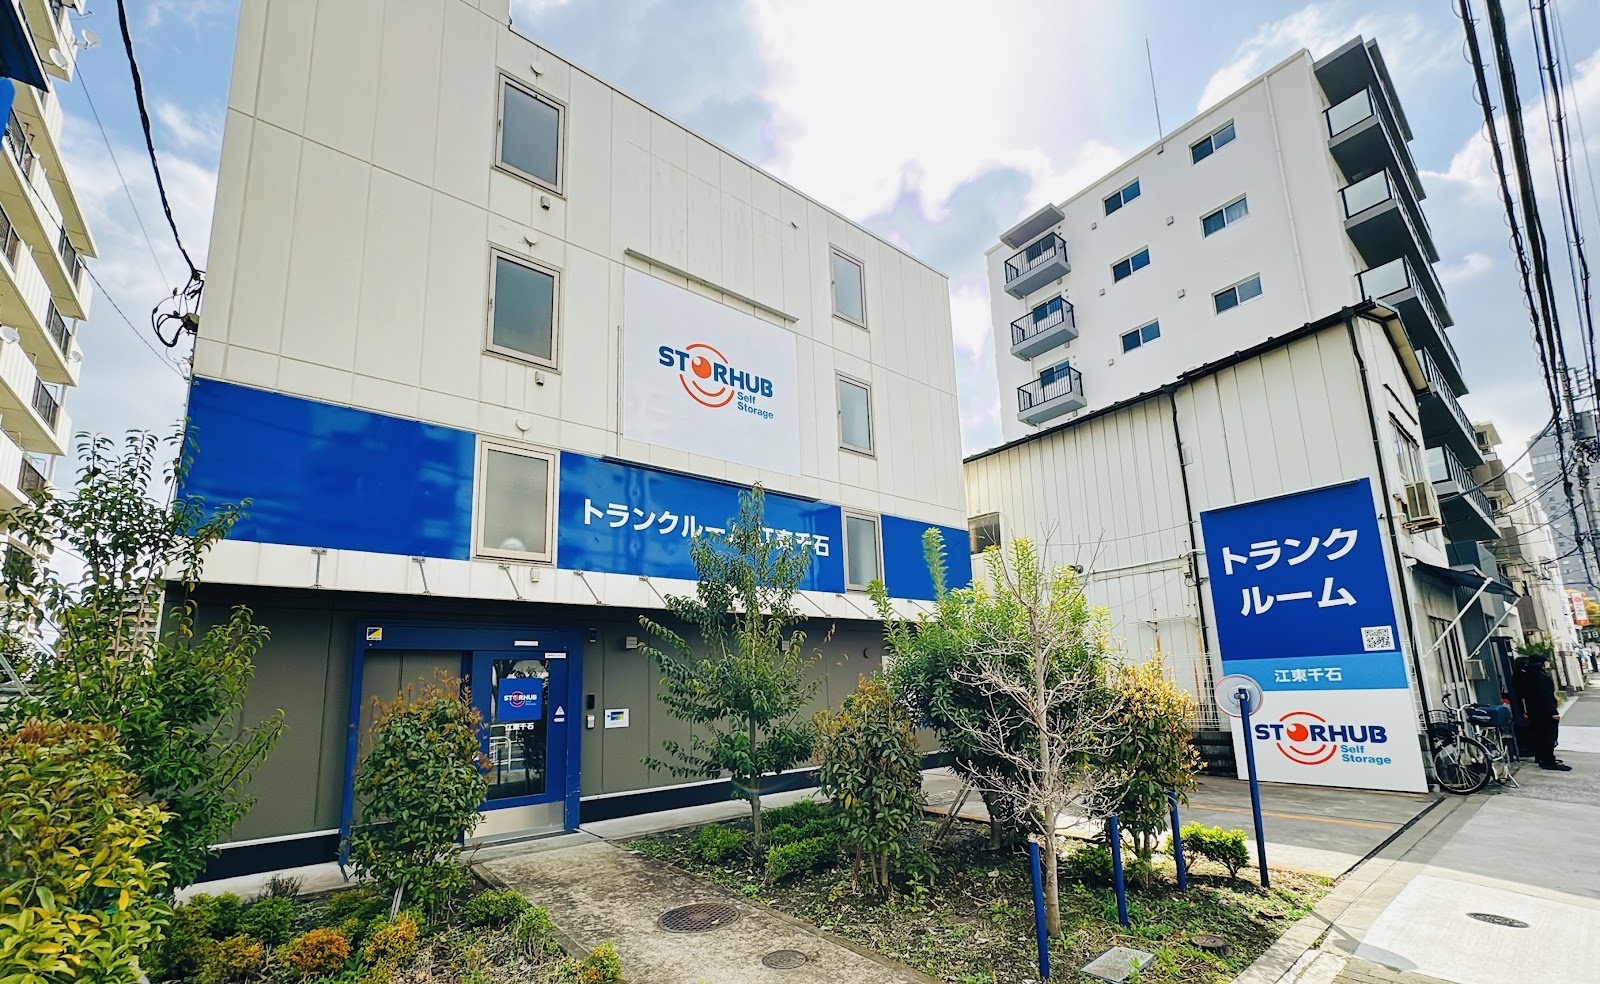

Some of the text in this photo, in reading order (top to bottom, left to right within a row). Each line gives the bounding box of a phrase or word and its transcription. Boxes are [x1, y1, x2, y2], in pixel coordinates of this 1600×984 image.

[659, 345, 773, 398] STORHUB
[737, 391, 756, 404] Self
[737, 401, 774, 419] Storage
[1222, 528, 1358, 576] トランク
[1240, 577, 1357, 617] ルーム
[1274, 667, 1342, 682] 江東千石
[1254, 723, 1387, 743] STORHUB
[1340, 744, 1365, 754] Self
[1342, 754, 1392, 765] Storage
